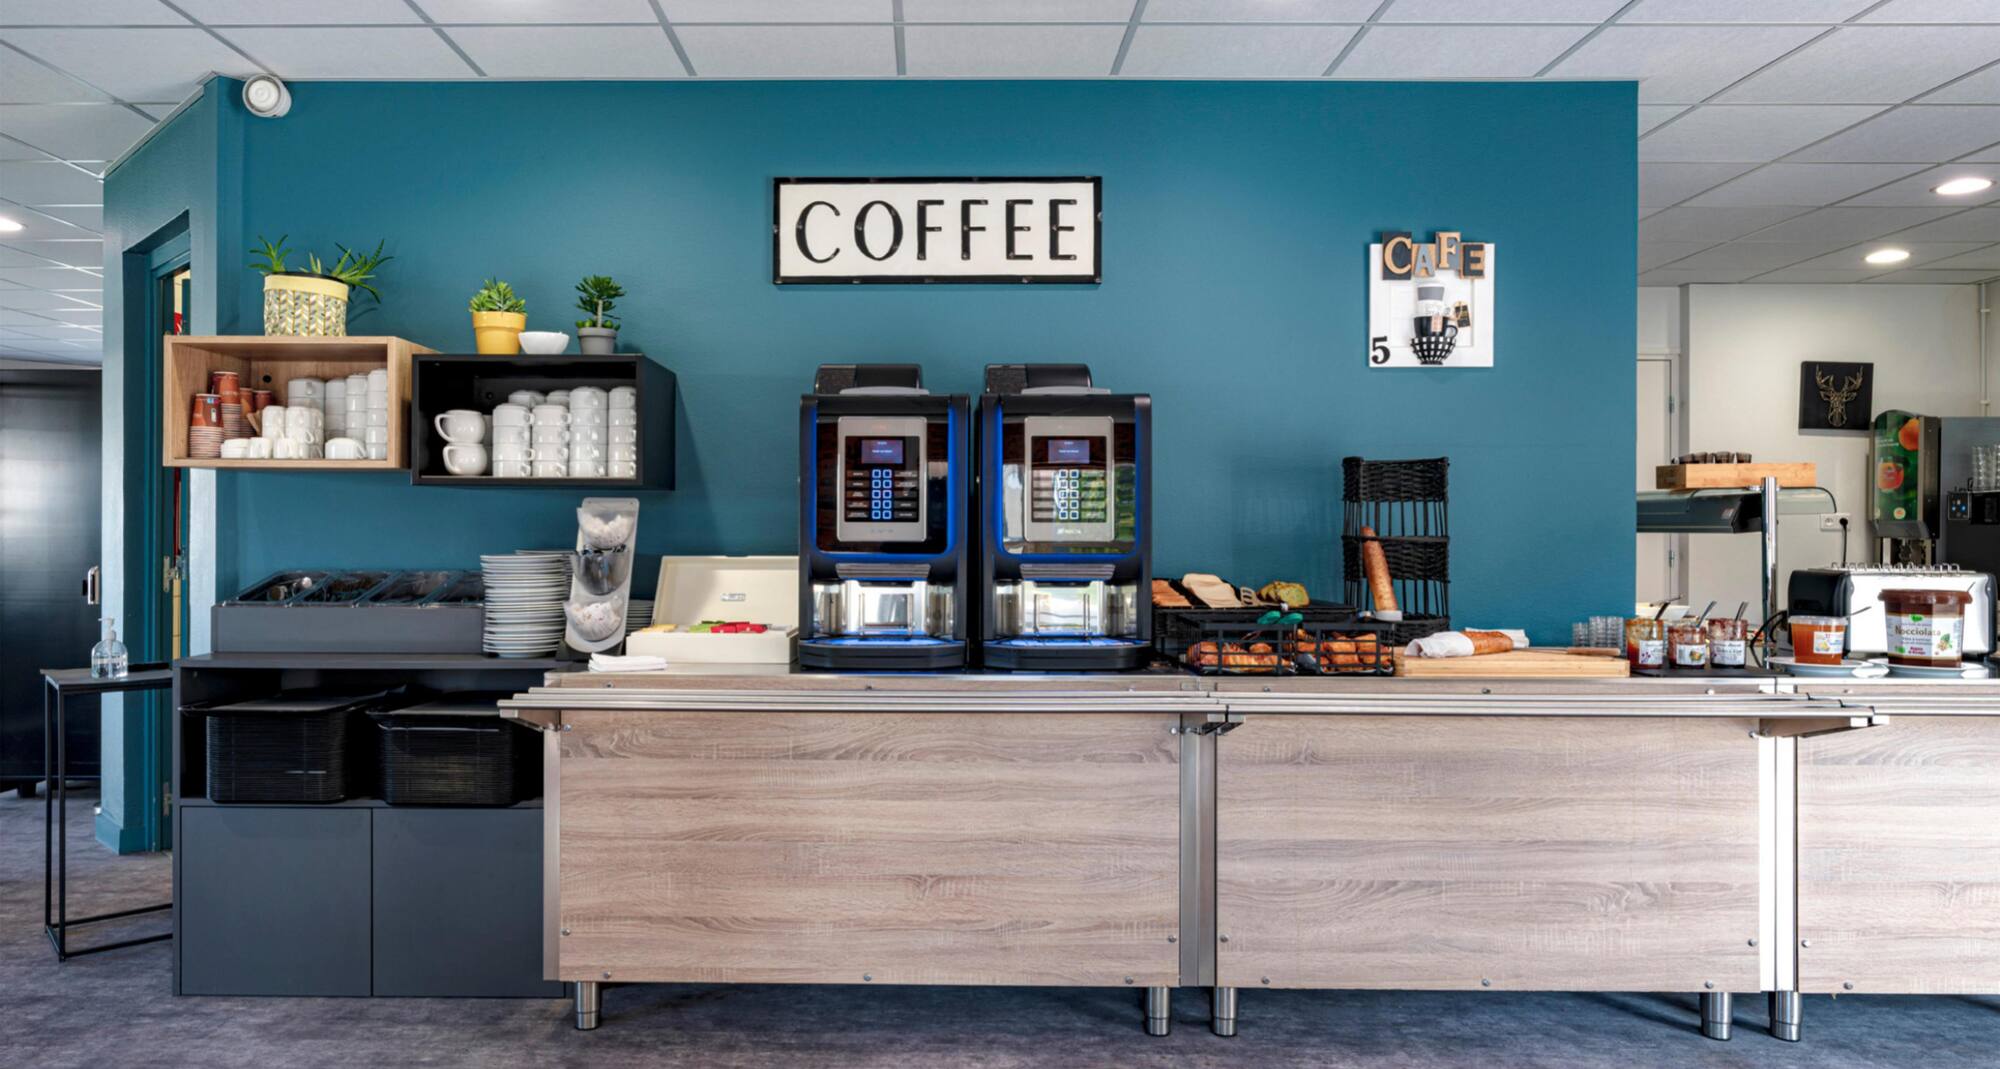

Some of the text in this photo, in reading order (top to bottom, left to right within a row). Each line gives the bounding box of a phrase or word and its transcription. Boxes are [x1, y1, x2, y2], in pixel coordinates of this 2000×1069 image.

[795, 199, 1078, 264] COFFEE
[1384, 233, 1484, 278] CAFE
[1371, 336, 1391, 364] 5
